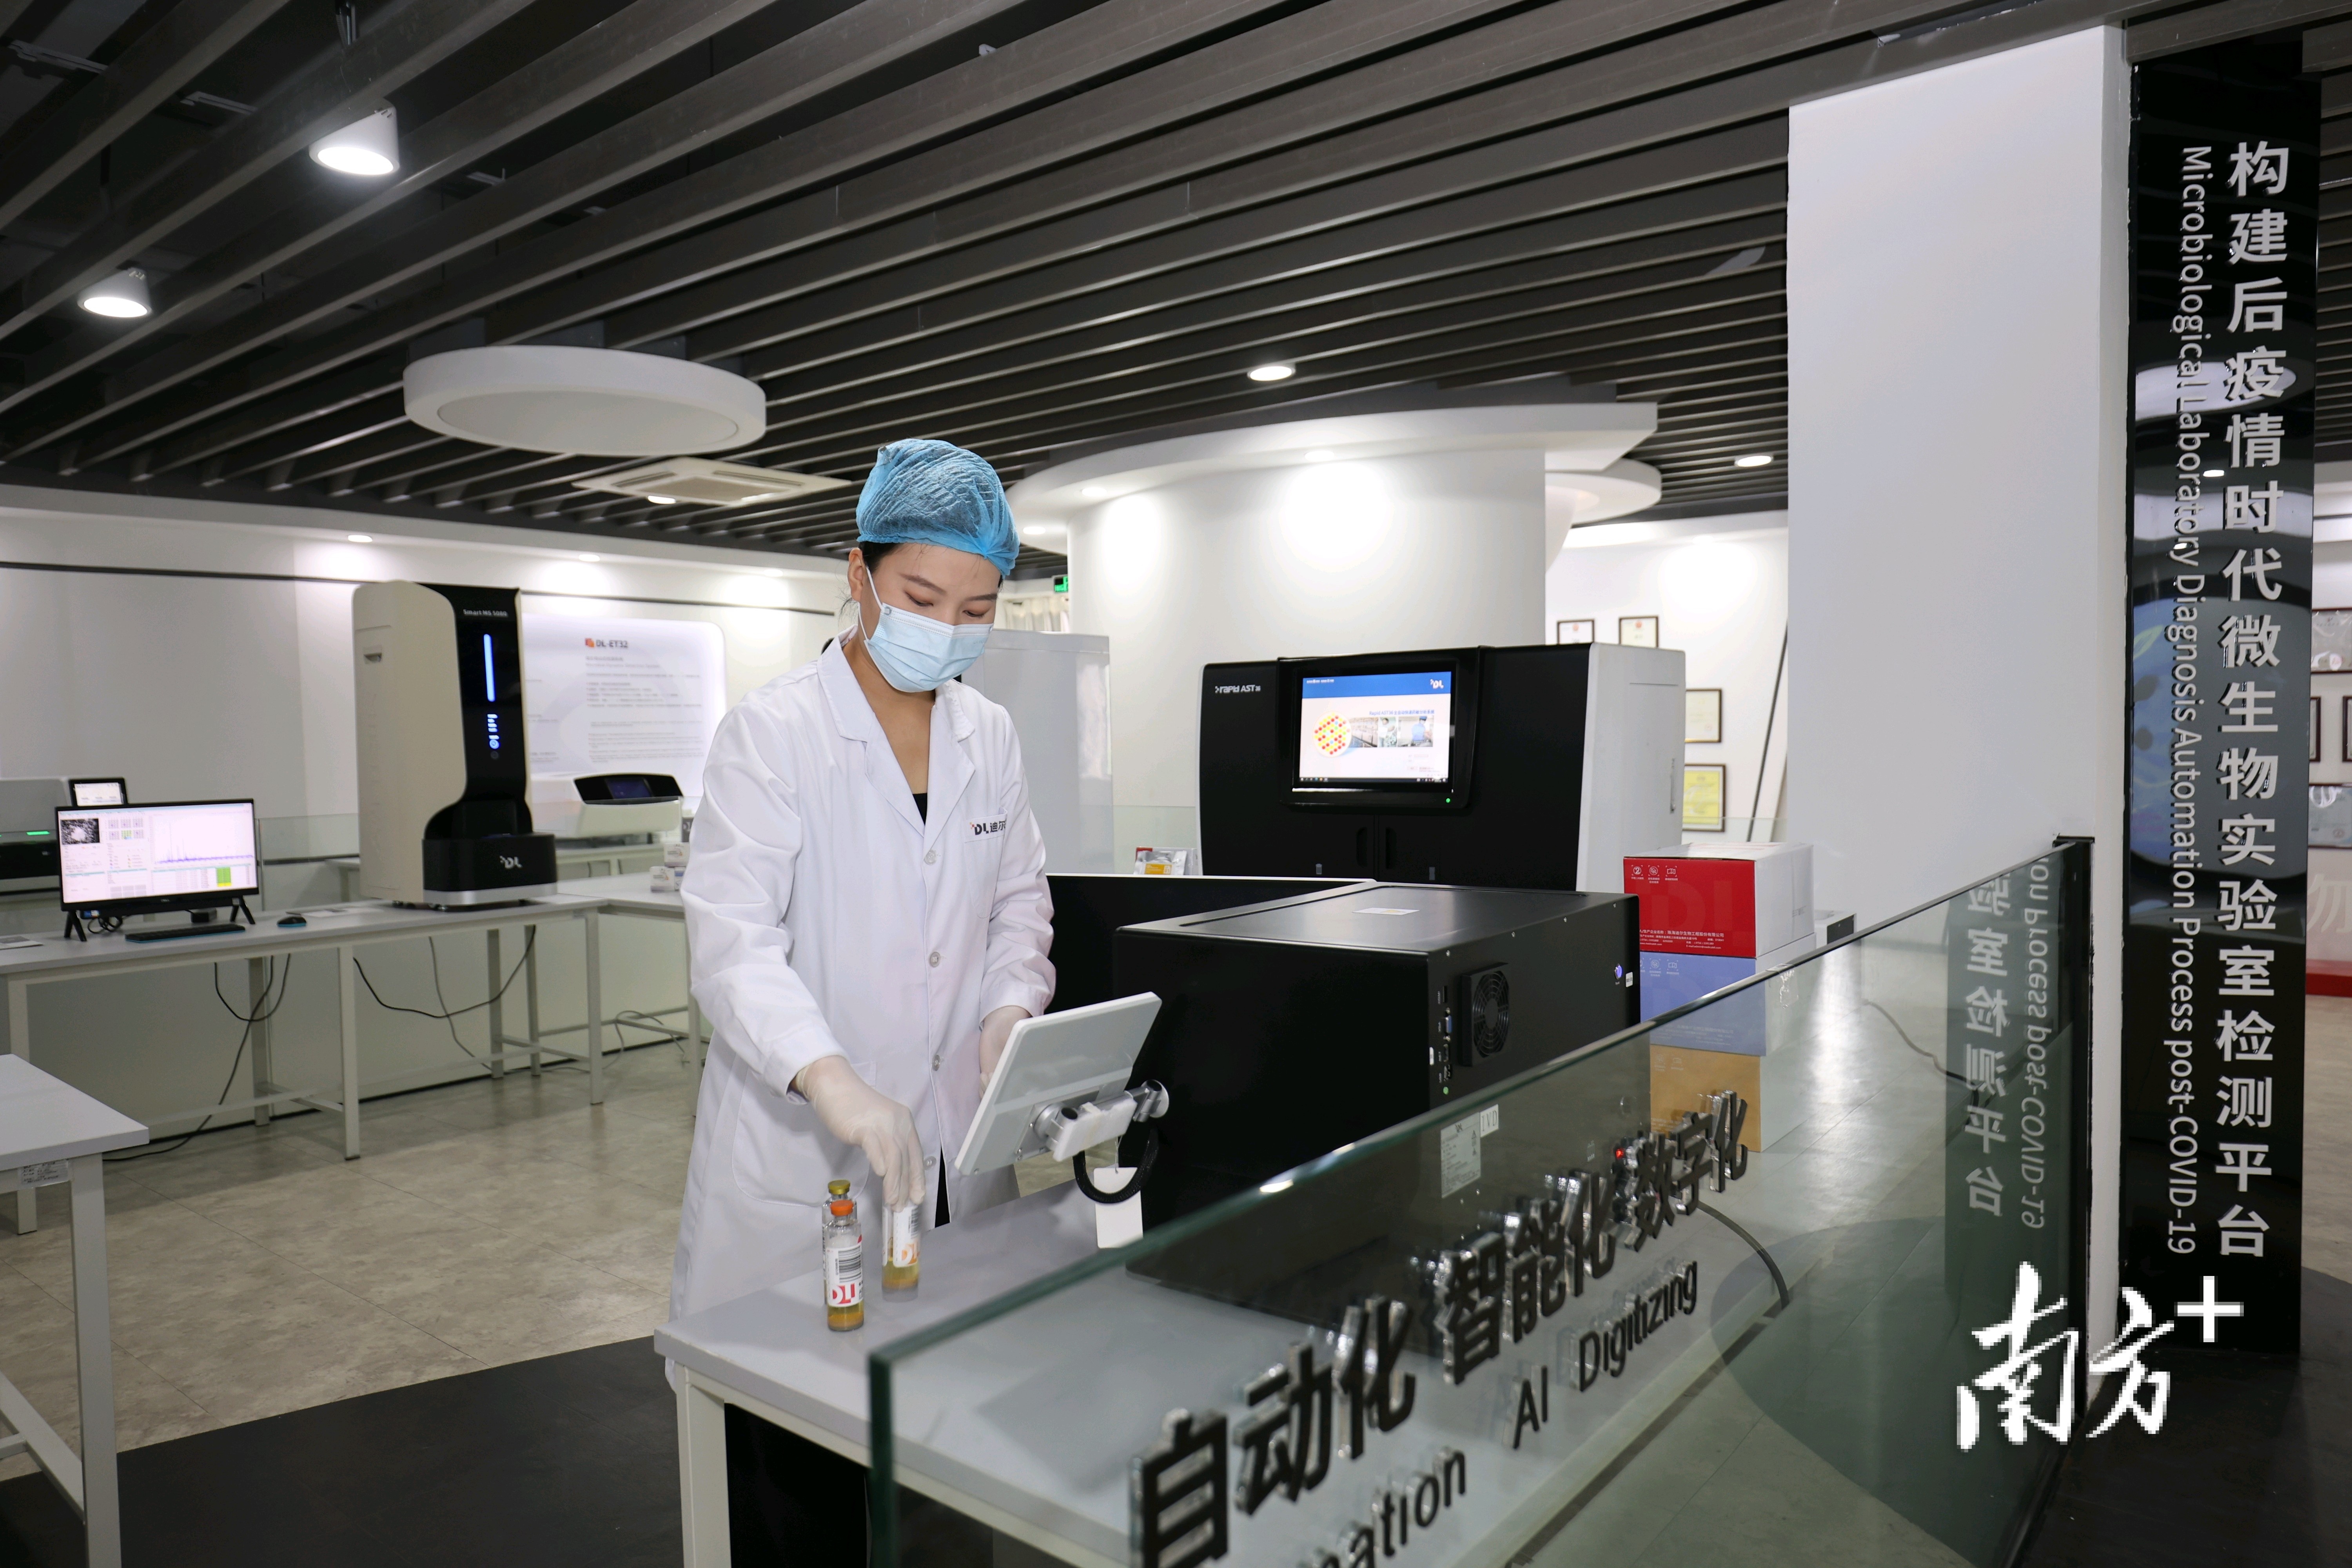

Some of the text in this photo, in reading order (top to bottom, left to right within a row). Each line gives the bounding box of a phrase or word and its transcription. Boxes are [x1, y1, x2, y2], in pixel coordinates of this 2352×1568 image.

[2163, 146, 2213, 1254] Microbiological Laboratory Diagnosis Automation Process post-COVID-19
[2216, 141, 2289, 1257] 构建后疫情时代微生物实验室检测平台
[1140, 1090, 1748, 1568] 自动化 智能化 数字化
[1513, 1365, 1548, 1450] AI
[1579, 1259, 1697, 1392] Digitizing
